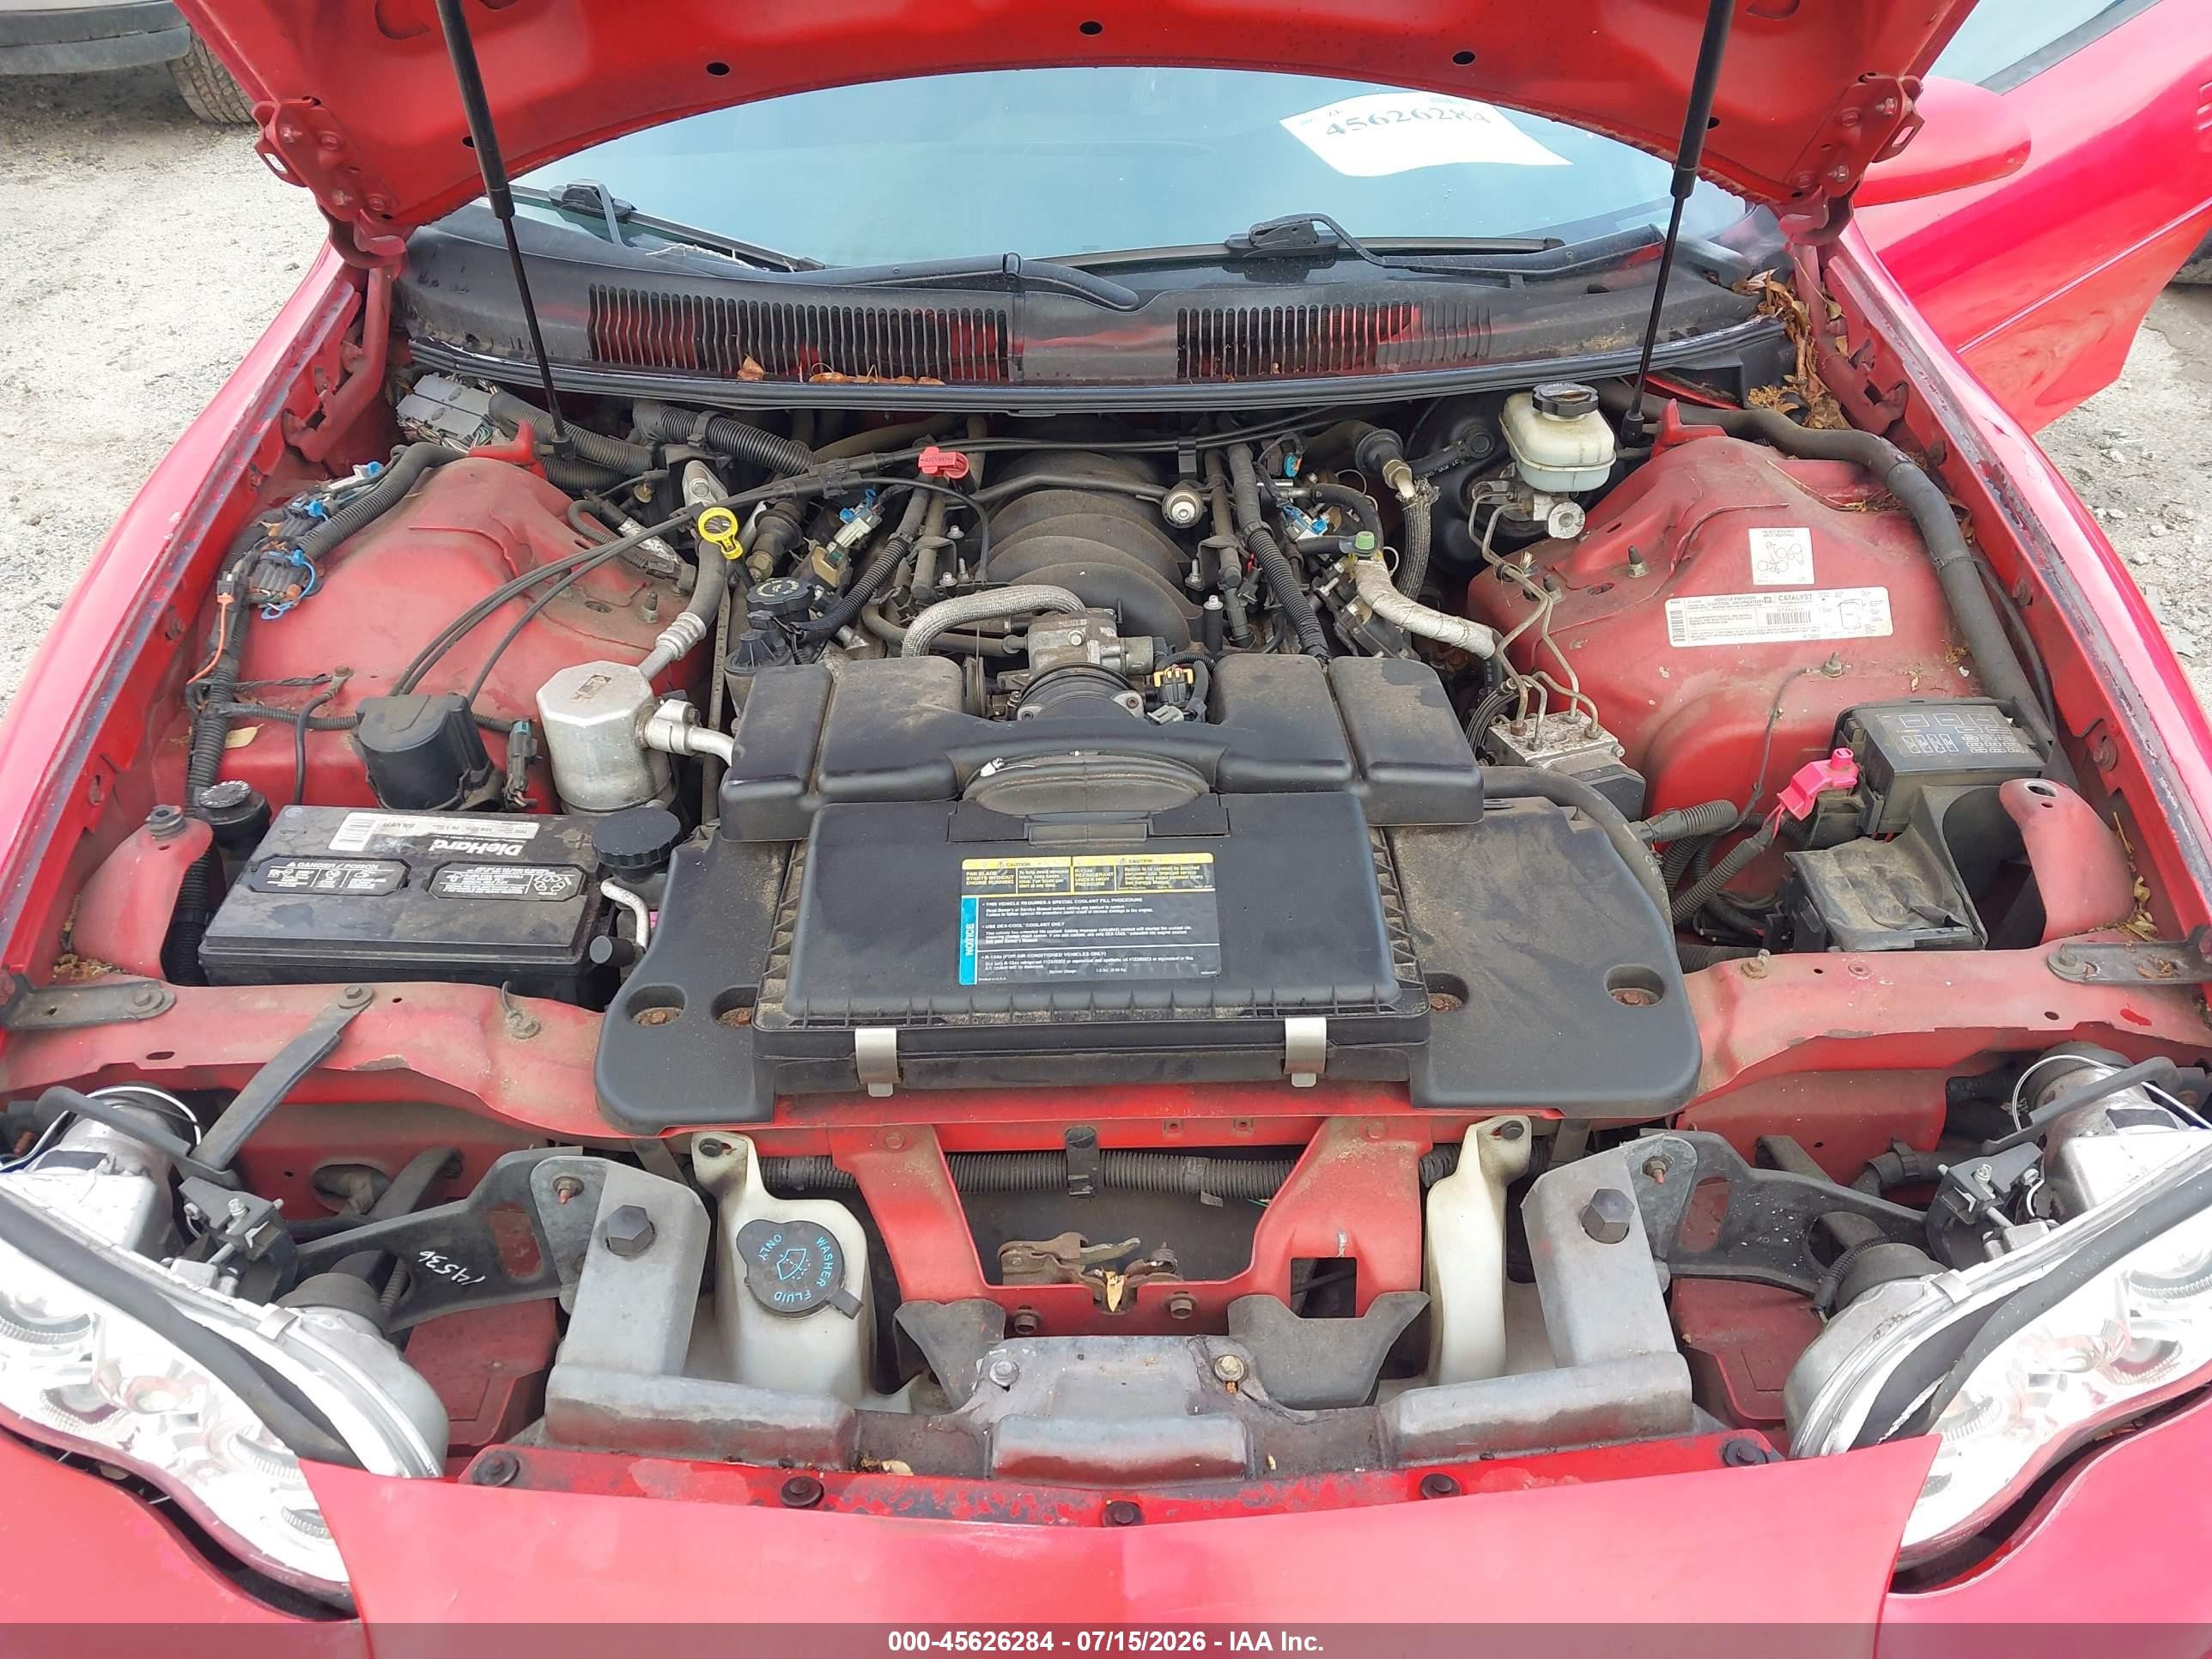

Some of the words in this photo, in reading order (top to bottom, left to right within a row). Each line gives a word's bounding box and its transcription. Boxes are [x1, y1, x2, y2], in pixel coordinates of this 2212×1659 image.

[1326, 107, 1491, 135] 45626284
[428, 839, 526, 856] DieHard
[965, 923, 975, 955] NOTICE
[757, 1234, 782, 1261] ONLY
[417, 1250, 486, 1285] 14536
[816, 1237, 834, 1287] WASHER
[774, 1290, 811, 1303] FLUID
